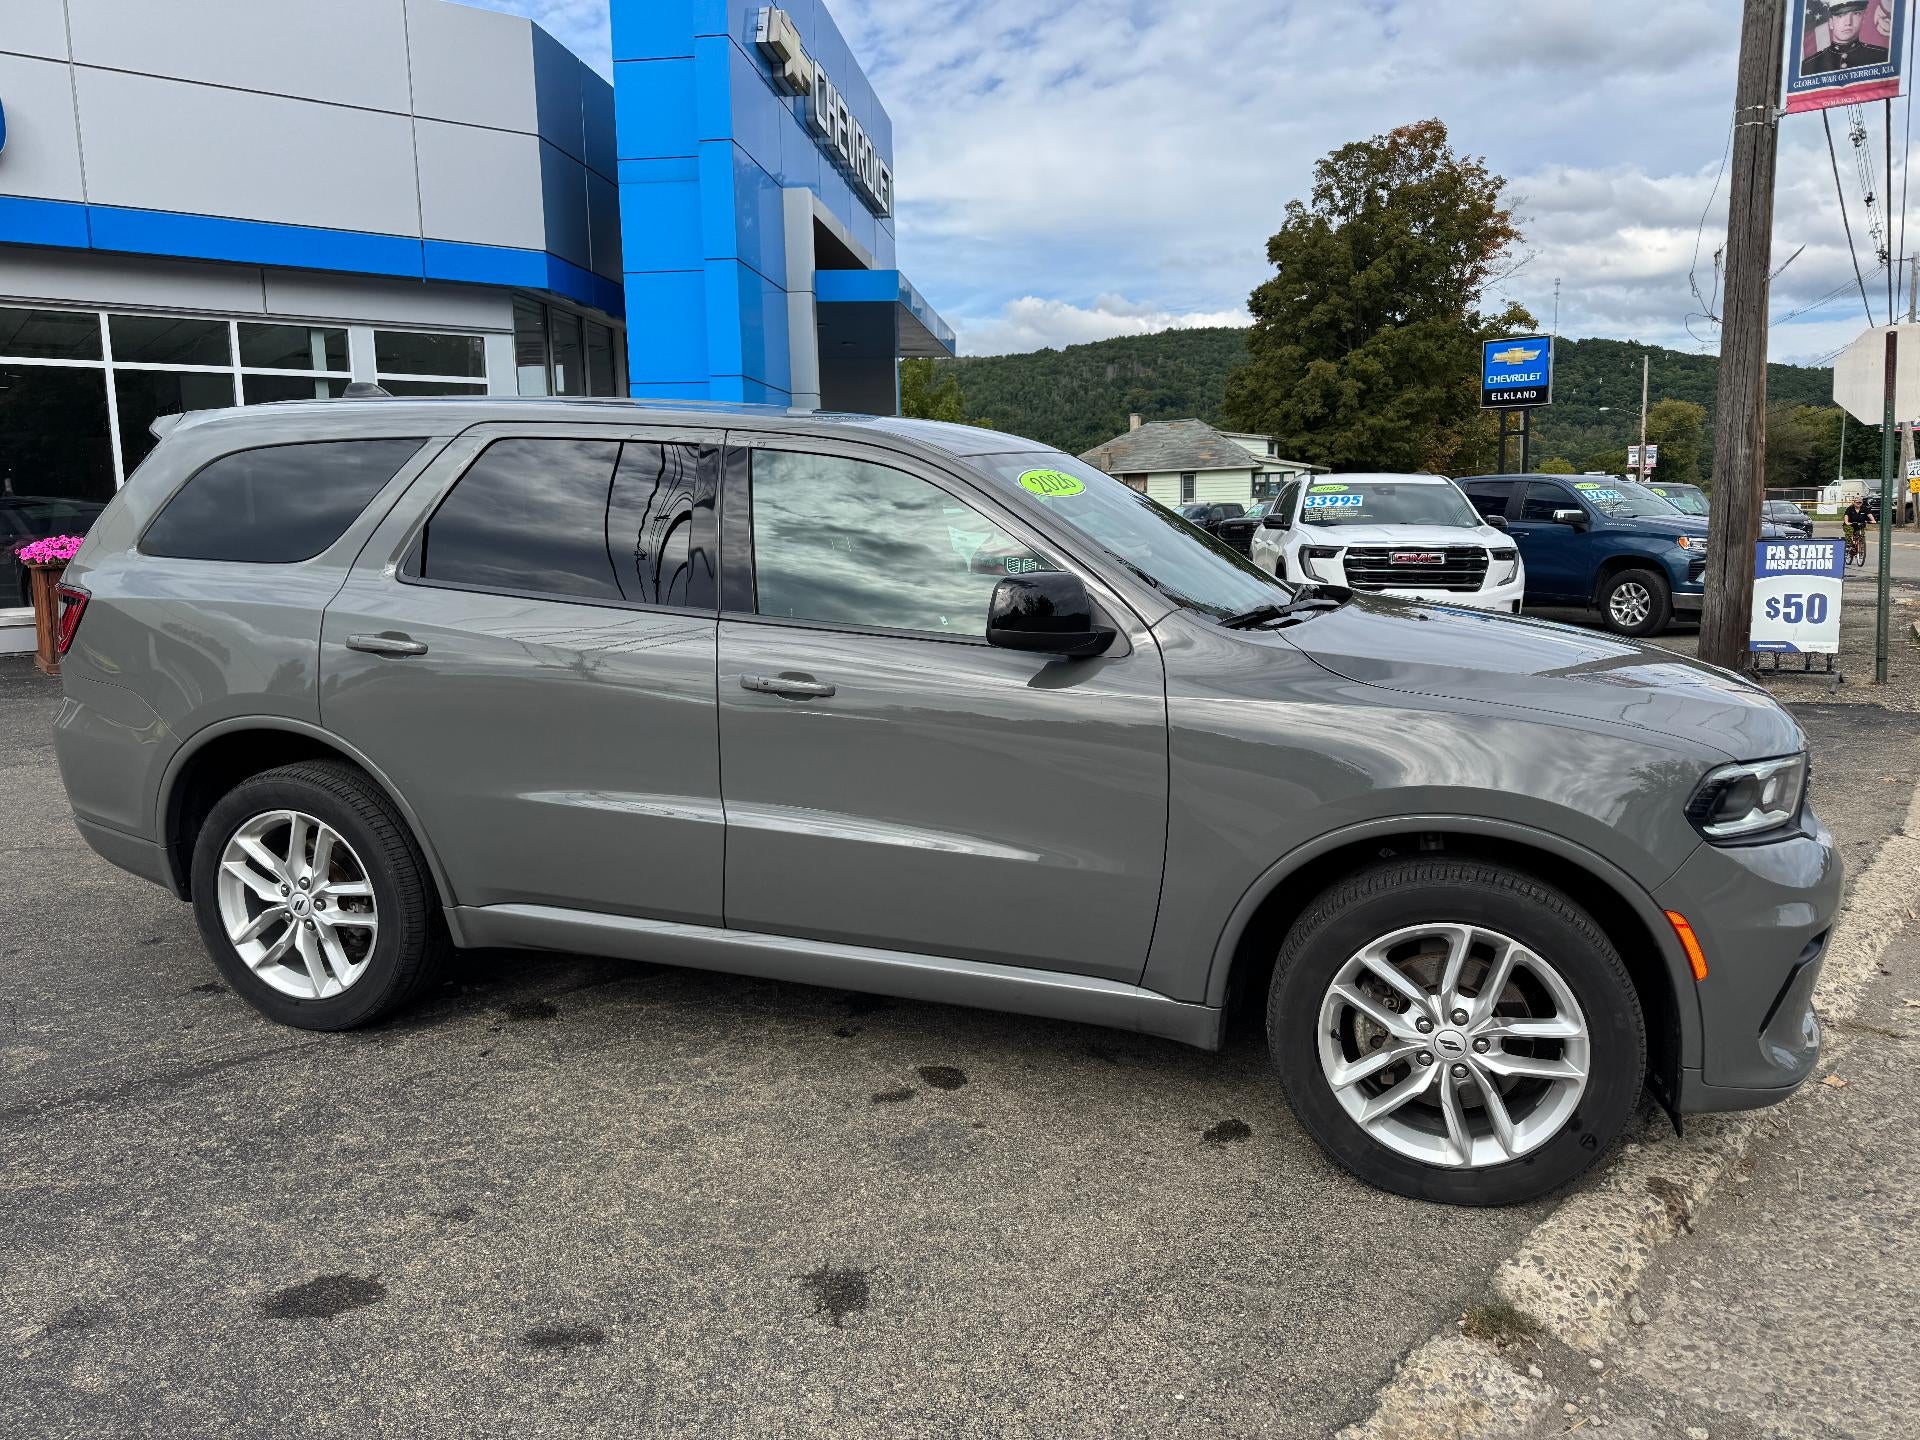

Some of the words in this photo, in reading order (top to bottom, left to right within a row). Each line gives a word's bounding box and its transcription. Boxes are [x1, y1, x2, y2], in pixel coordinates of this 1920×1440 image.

[1793, 77, 1820, 89] GLOBAL
[1821, 75, 1837, 84] WAR
[1838, 73, 1850, 82] ON
[1850, 69, 1881, 79] TERROR,
[1882, 66, 1895, 74] KIA
[809, 59, 893, 218] CHEVROLET
[1488, 372, 1542, 384] CHEVROLET
[1491, 390, 1537, 400] ELKLAND
[1305, 495, 1362, 507] 33995
[1766, 546, 1786, 559] PA
[1788, 544, 1834, 559] STATE
[1393, 553, 1442, 563] GMC
[1765, 559, 1833, 570] INSPECTION
[1765, 592, 1828, 625] $50
